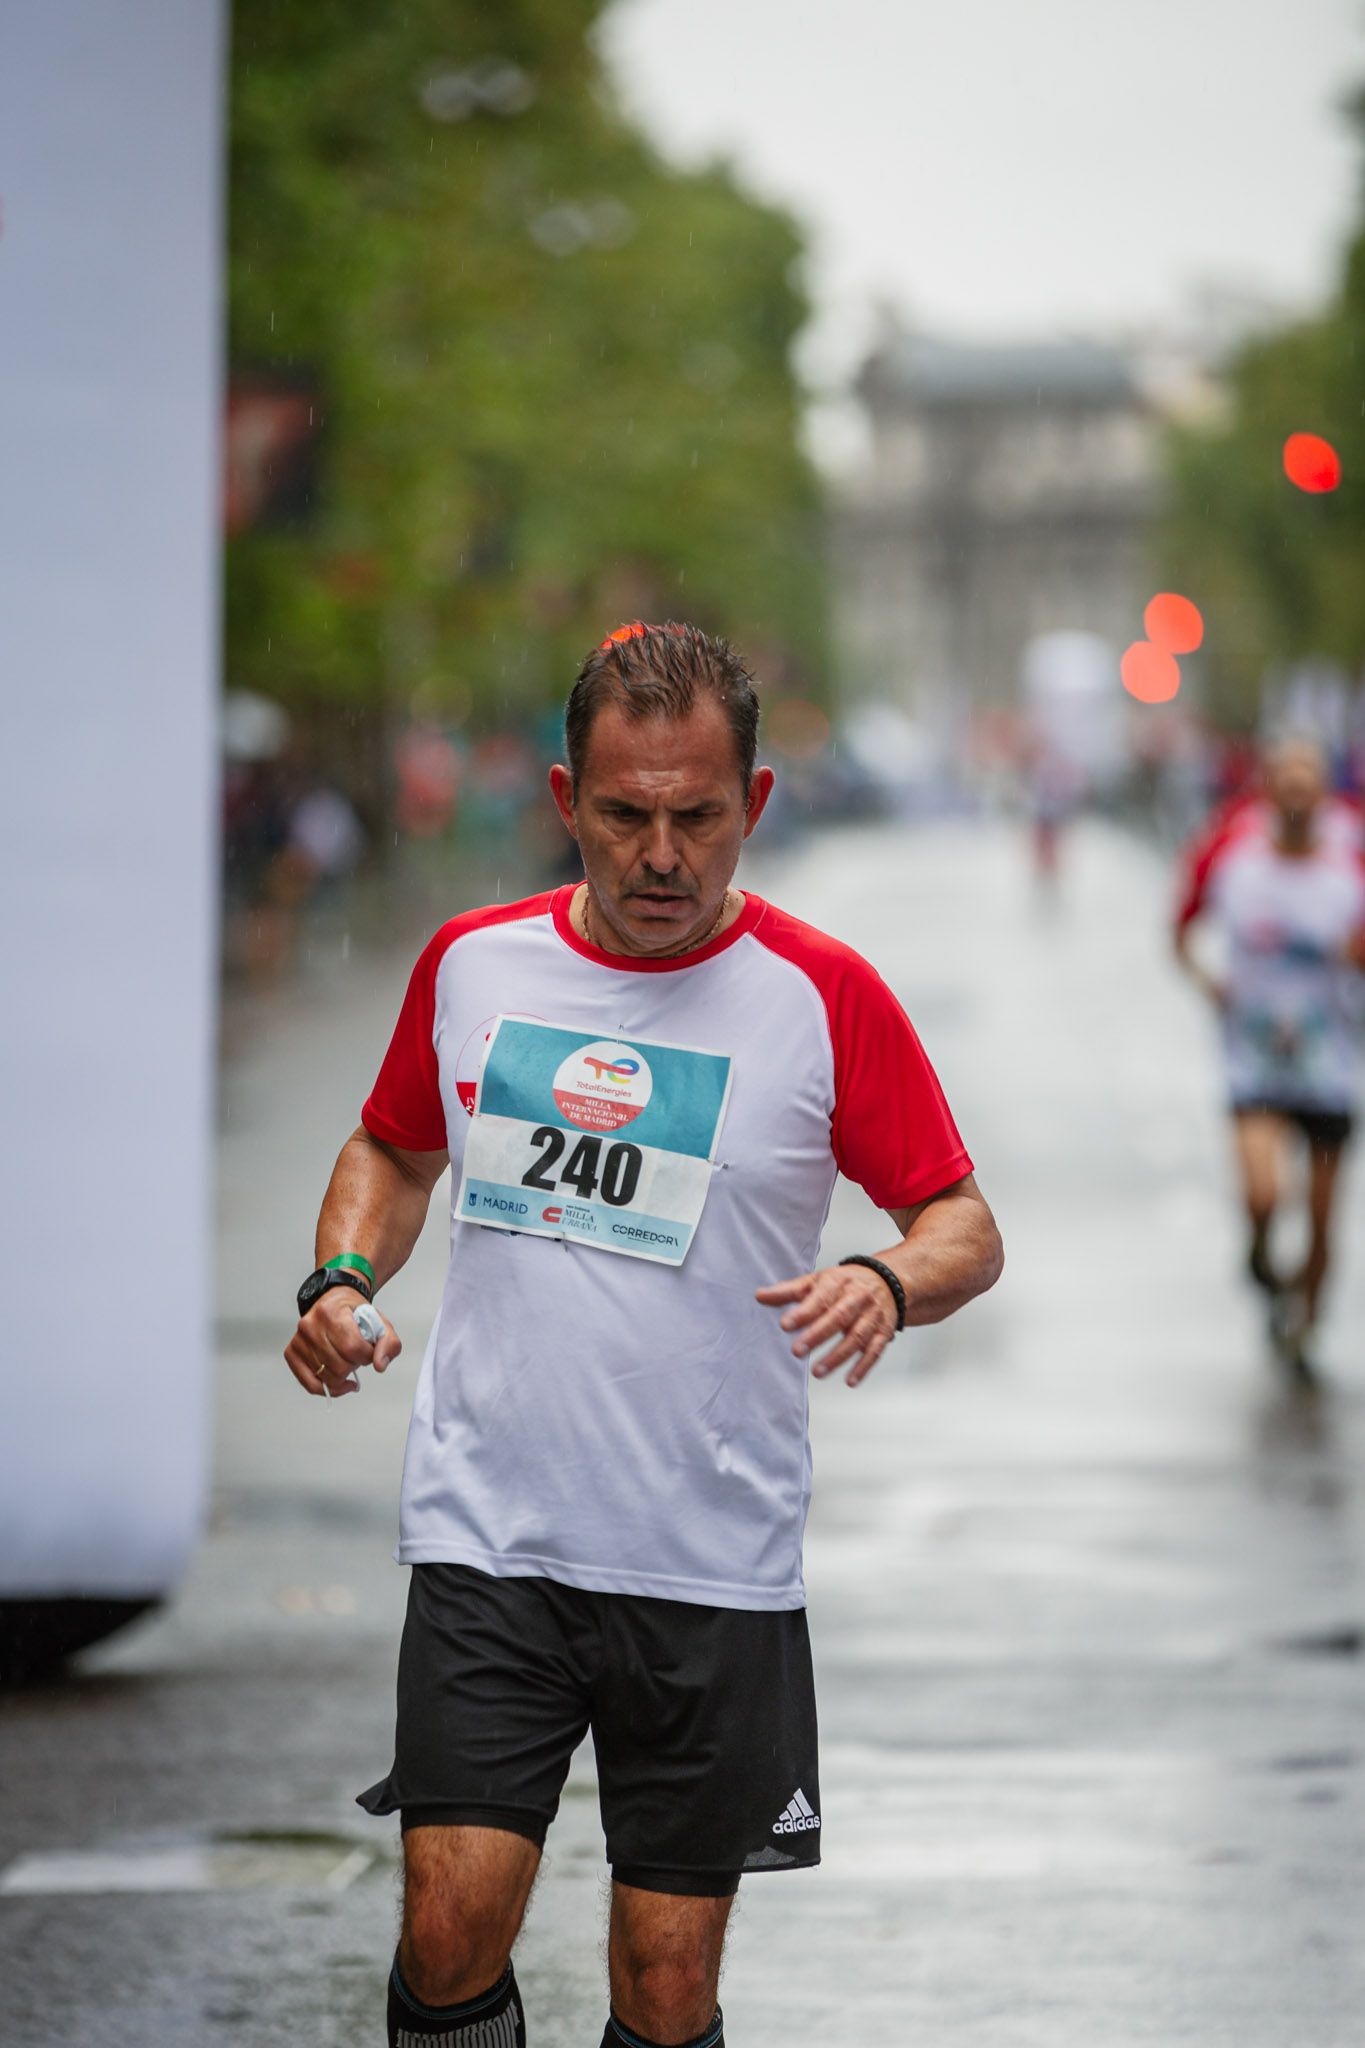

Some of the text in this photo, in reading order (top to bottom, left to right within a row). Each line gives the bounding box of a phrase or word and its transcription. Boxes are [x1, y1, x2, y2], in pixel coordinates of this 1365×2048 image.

[576, 1081, 632, 1097] TotalEnergies
[585, 1098, 611, 1110] MILLA
[569, 1111, 617, 1127] DE MADRID
[521, 1126, 643, 1207] 240
[483, 1197, 528, 1214] MADRID
[565, 1208, 594, 1223] MILLA
[772, 1816, 821, 1834] adidas
